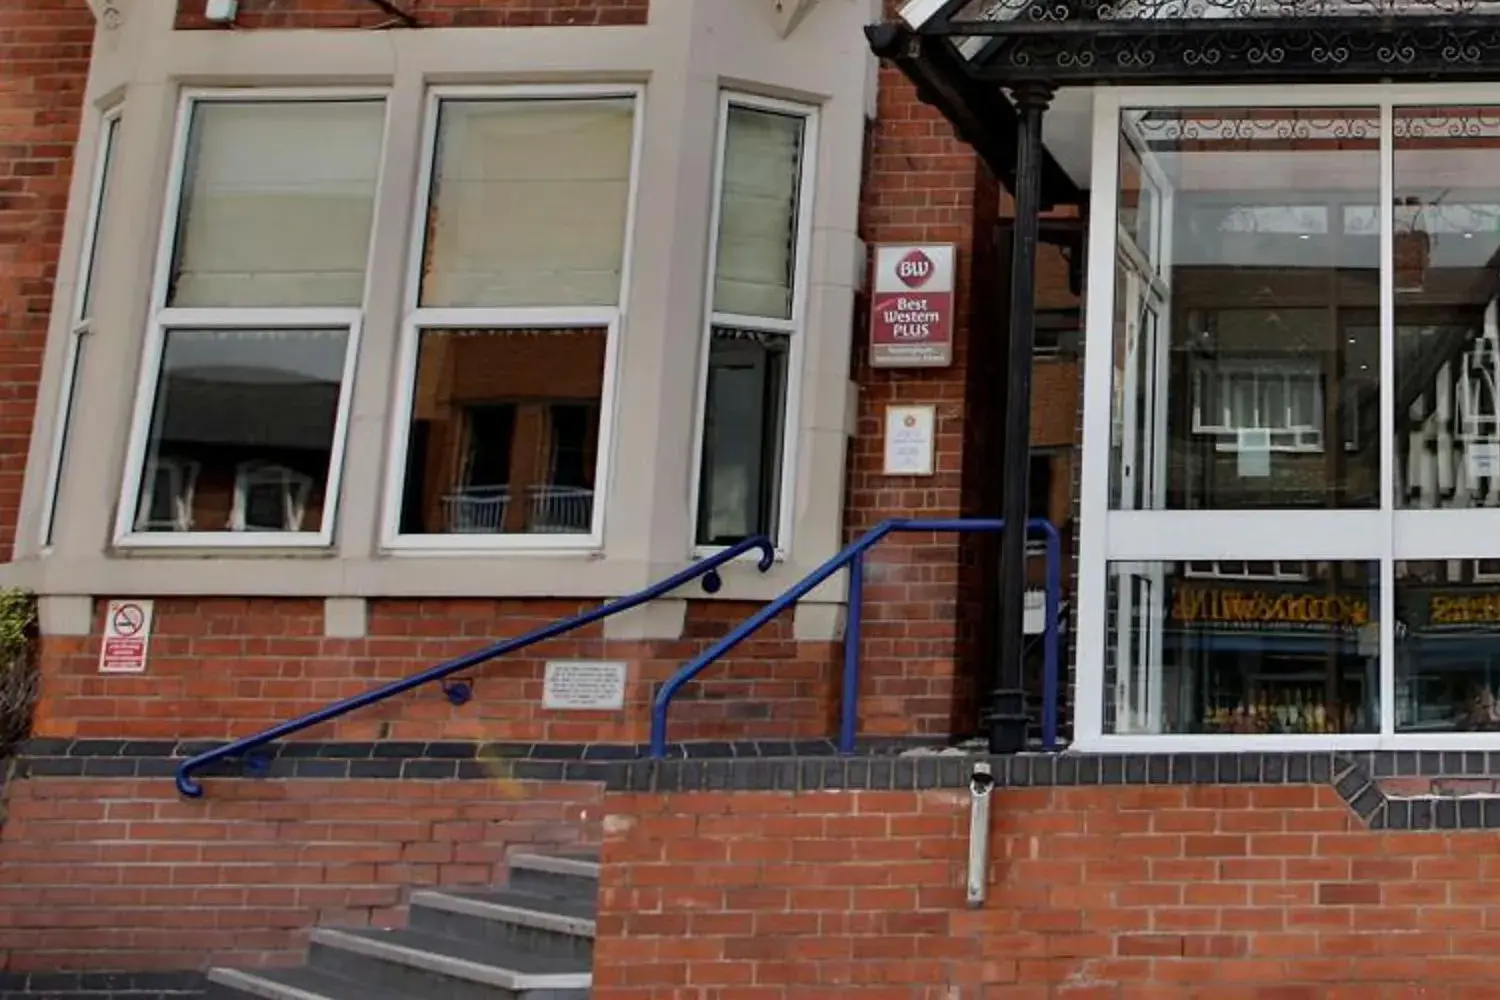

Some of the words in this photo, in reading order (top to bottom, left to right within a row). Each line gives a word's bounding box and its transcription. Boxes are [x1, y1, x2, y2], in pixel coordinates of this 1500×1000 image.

[900, 261, 928, 278] BW
[897, 298, 927, 311] Best
[884, 311, 939, 323] Western
[893, 323, 929, 338] PLUS
